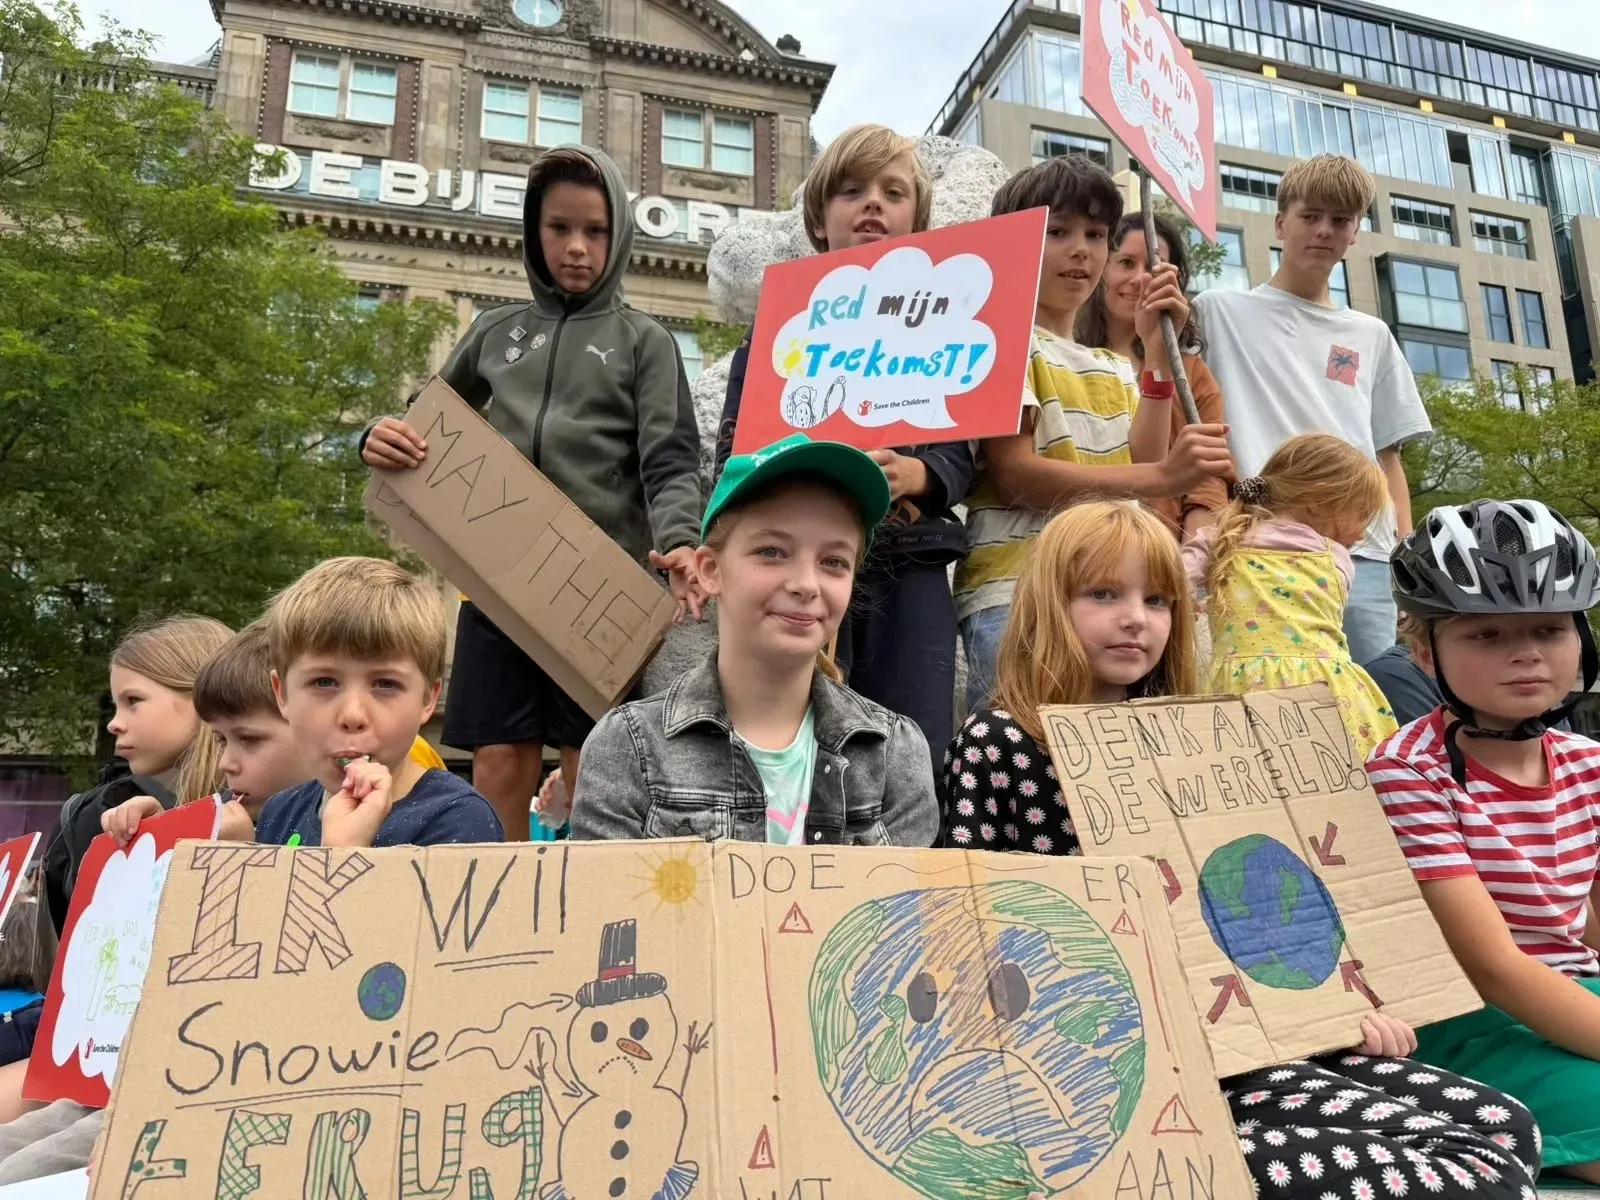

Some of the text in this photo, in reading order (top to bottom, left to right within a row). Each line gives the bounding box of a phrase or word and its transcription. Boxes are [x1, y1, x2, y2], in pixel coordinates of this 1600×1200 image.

[249, 143, 364, 199] DE
[877, 289, 949, 328] mijn
[902, 398, 930, 407] Children
[423, 411, 650, 665] MAY THE
[1048, 701, 1310, 780] DENK AAN
[1076, 704, 1367, 846] DE WERELD!
[729, 853, 1142, 902] DOE ER
[168, 846, 375, 986] IK
[165, 1001, 440, 1095] Snowie
[1114, 1147, 1215, 1200] AAN
